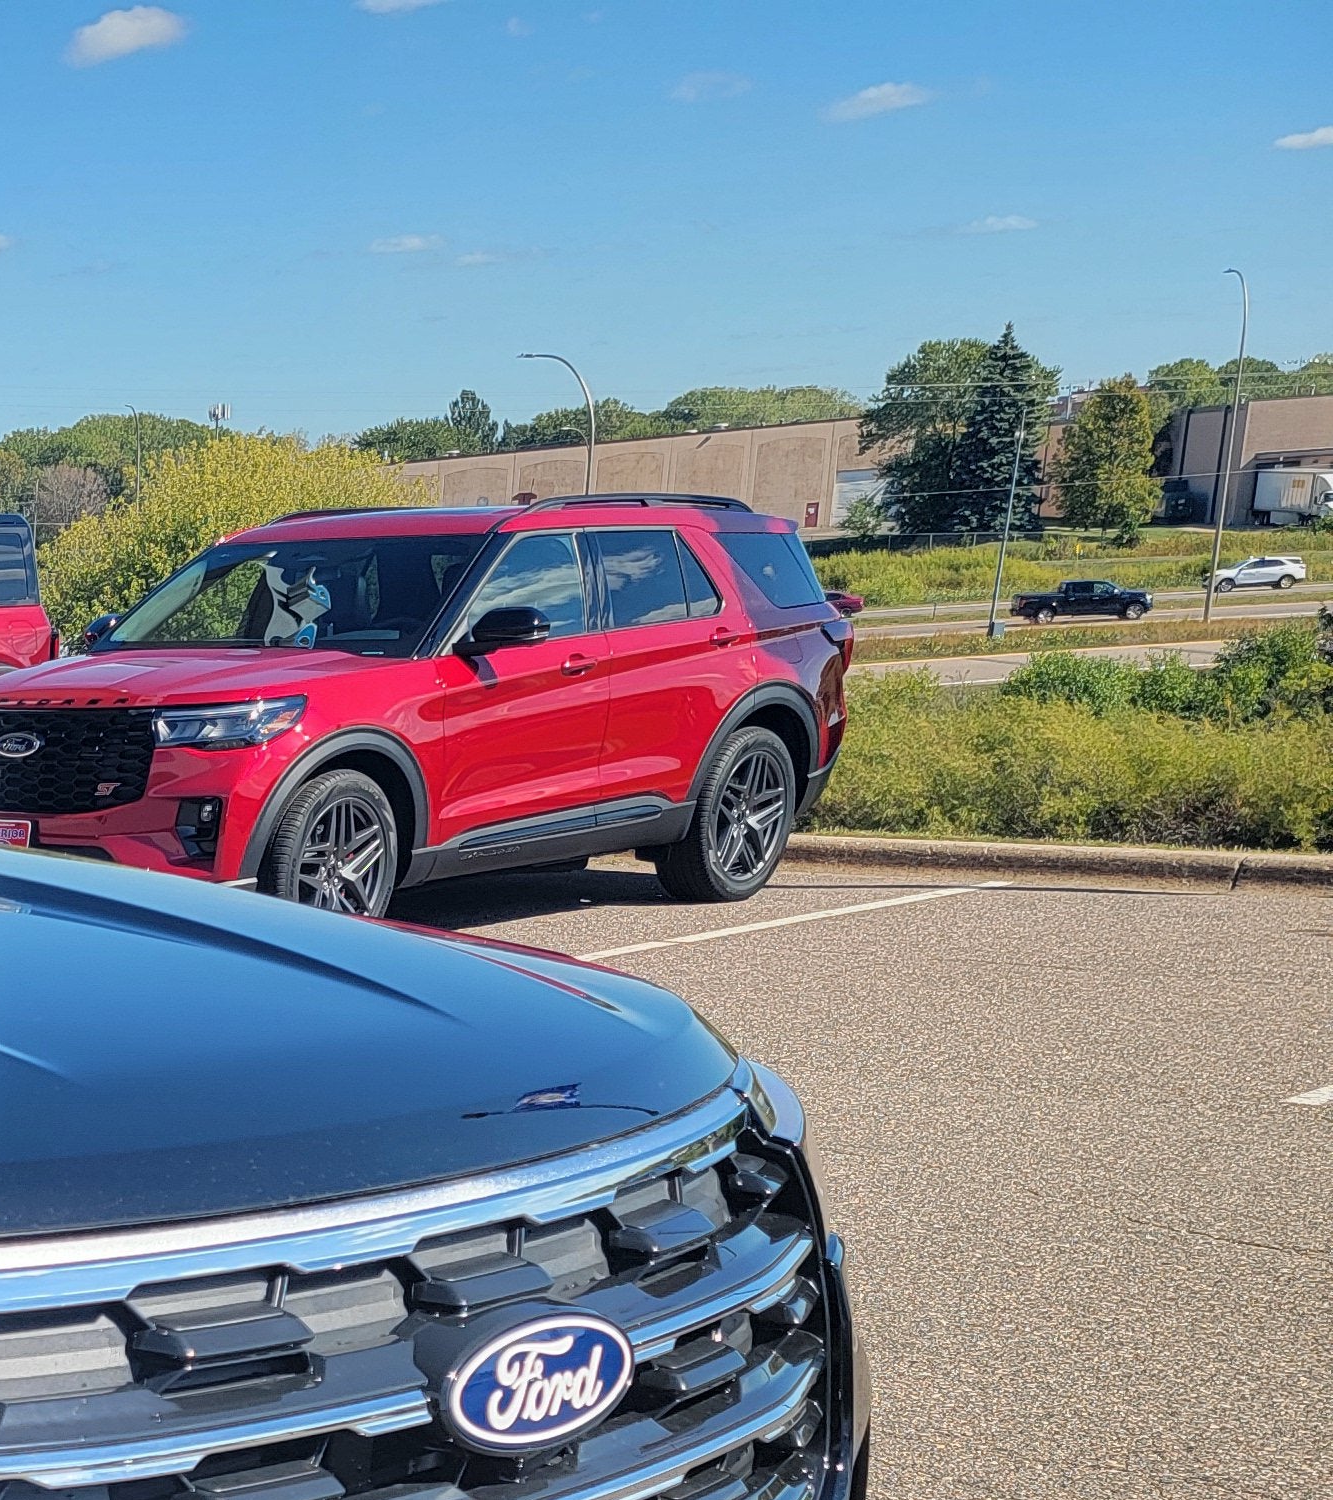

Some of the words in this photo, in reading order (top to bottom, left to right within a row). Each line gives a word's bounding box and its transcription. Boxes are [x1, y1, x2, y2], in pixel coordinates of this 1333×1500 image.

[2, 737, 27, 752] Ford
[94, 783, 122, 796] ST
[486, 1335, 604, 1431] Ford
